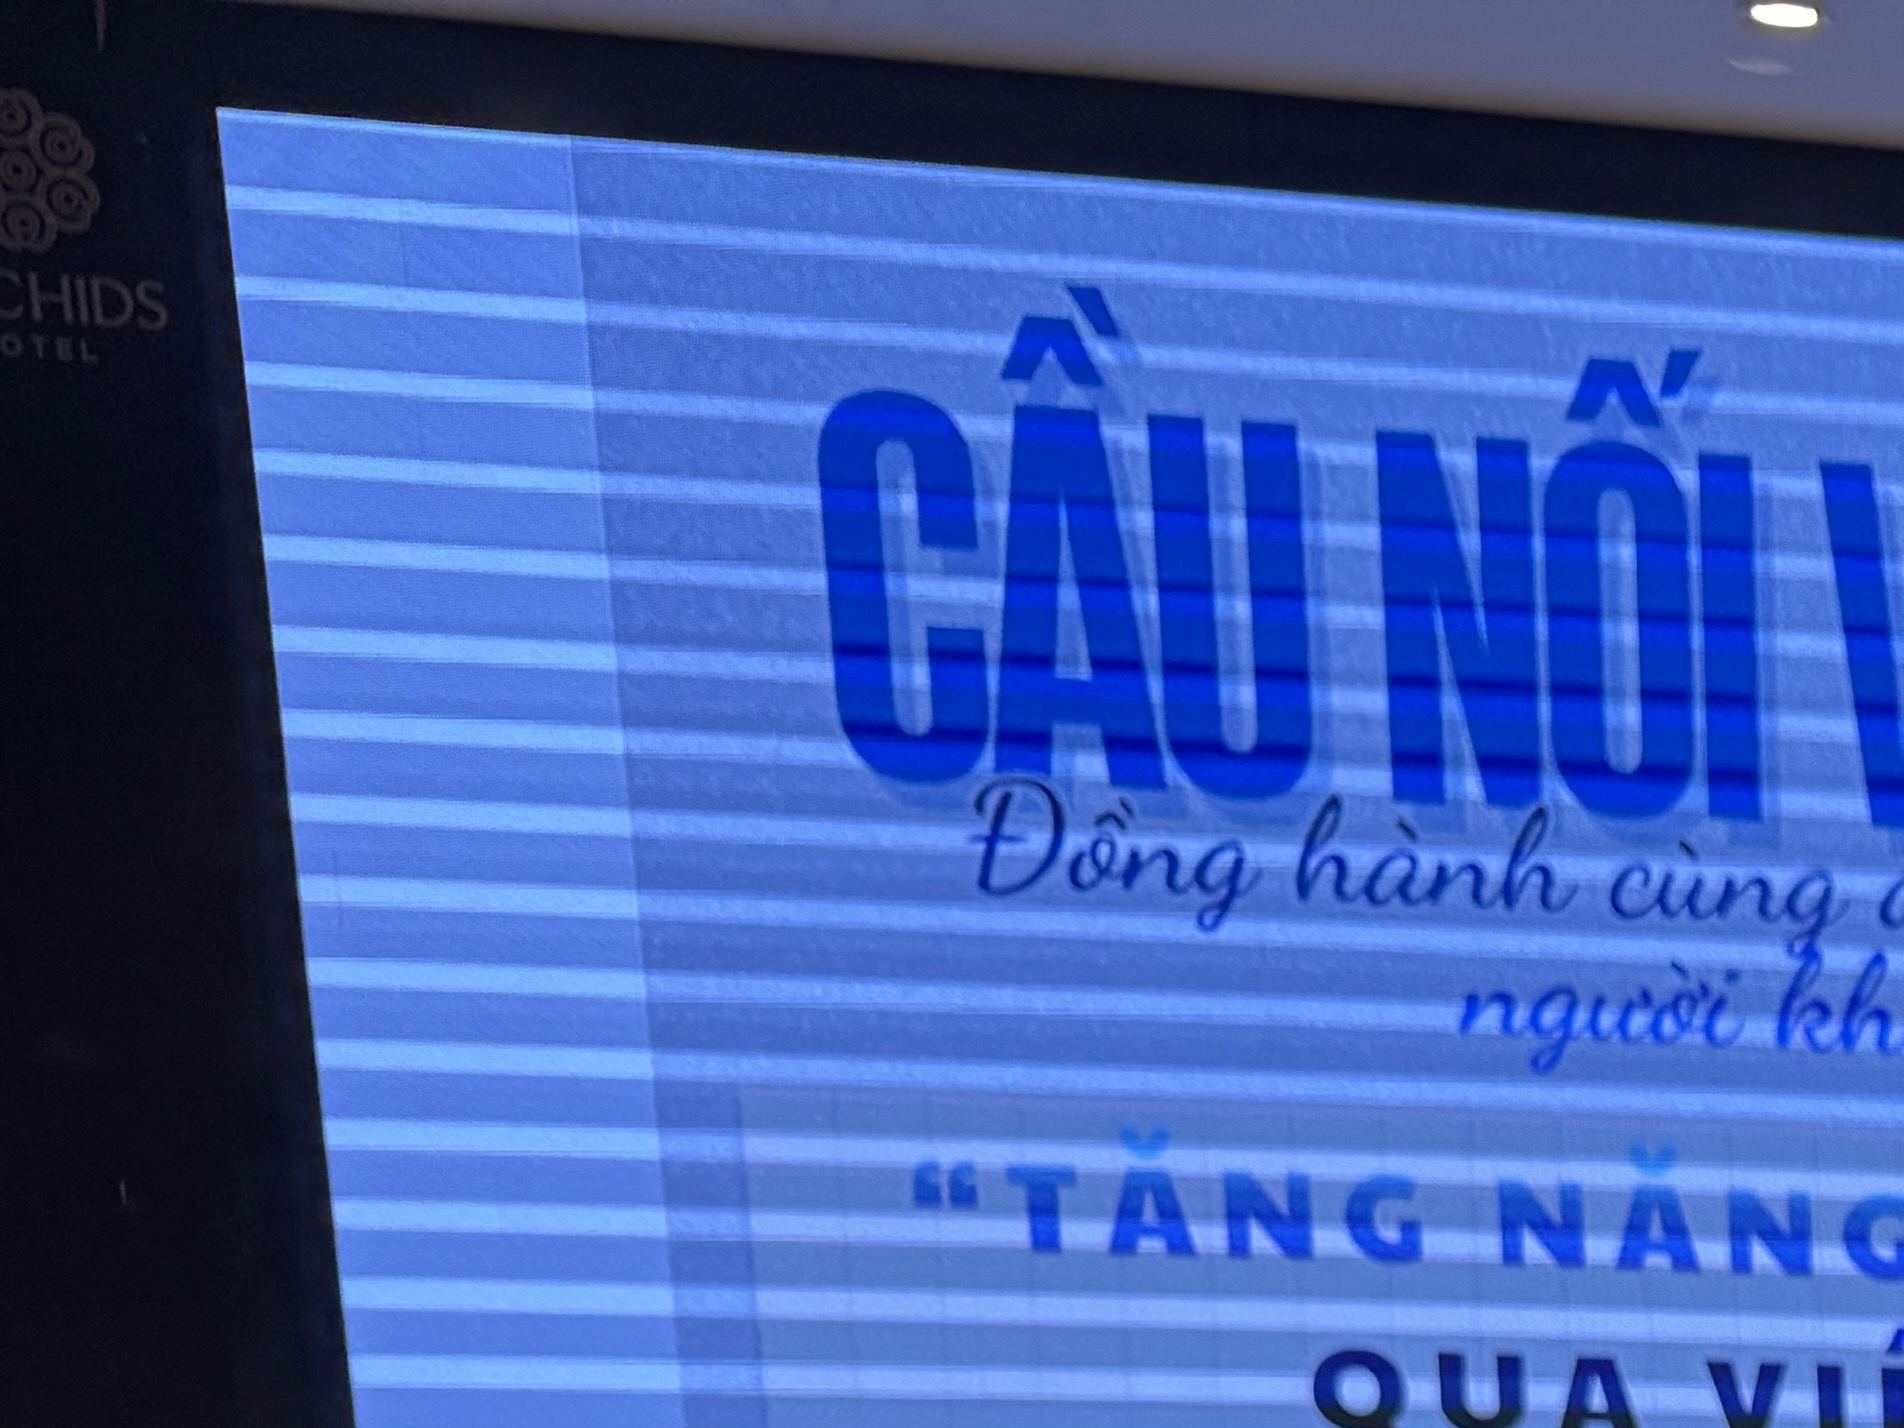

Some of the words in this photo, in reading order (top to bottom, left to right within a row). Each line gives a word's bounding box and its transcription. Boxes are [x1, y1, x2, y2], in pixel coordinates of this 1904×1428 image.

[816, 286, 1312, 798] CẦU
[1374, 349, 1765, 821] NỐI
[968, 776, 1263, 933] Đồng
[1293, 795, 1578, 912] hành
[1609, 842, 1840, 958] cùng
[1456, 961, 1746, 1075] người
